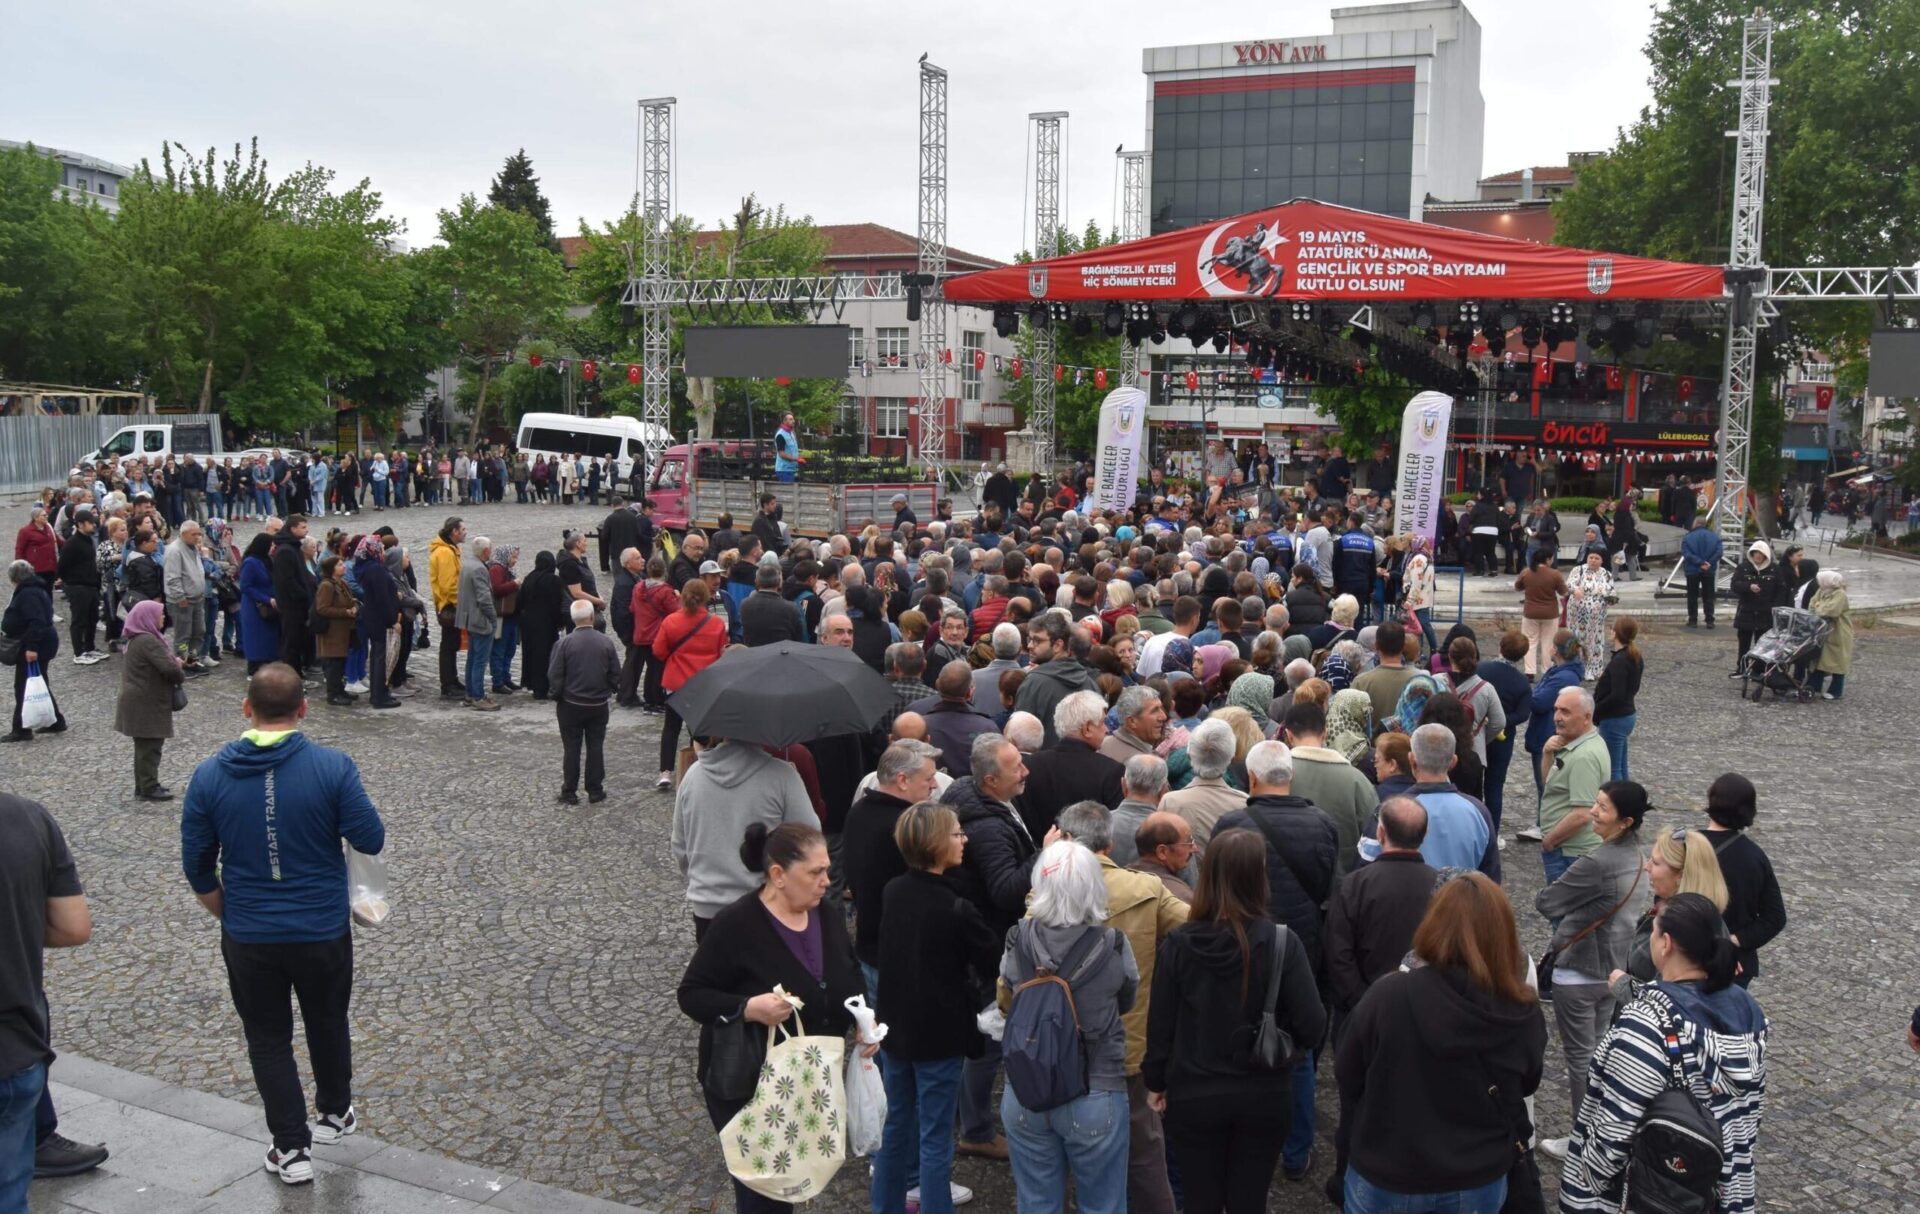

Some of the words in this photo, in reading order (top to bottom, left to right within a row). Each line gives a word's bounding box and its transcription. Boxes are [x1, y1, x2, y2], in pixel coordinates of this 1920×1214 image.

[1233, 41, 1286, 64] YÖN
[1290, 45, 1326, 63] AVM
[1299, 231, 1315, 243] 19
[1318, 231, 1366, 243] MAYIS
[1381, 247, 1433, 261] ANMA,
[1081, 265, 1145, 274] BAĞIMSIZLIK
[1148, 262, 1176, 275] ATEŞİ
[1297, 261, 1362, 277] GENÇLİK
[1364, 263, 1384, 275] VE
[1387, 263, 1430, 275] SPOR
[1432, 263, 1506, 276] BAYRAMI
[1083, 275, 1101, 288] HİÇ
[1103, 275, 1176, 286] SÖNMEYECEK!
[1296, 278, 1345, 290] KUTLU
[1348, 278, 1405, 291] OLSUN!
[1658, 431, 1710, 441] LÜLEBURGAZ
[1101, 492, 1114, 504] VE
[1417, 456, 1435, 529] MÜDÜRLÜĞÜ
[1401, 504, 1415, 518] VE
[267, 825, 280, 866] START
